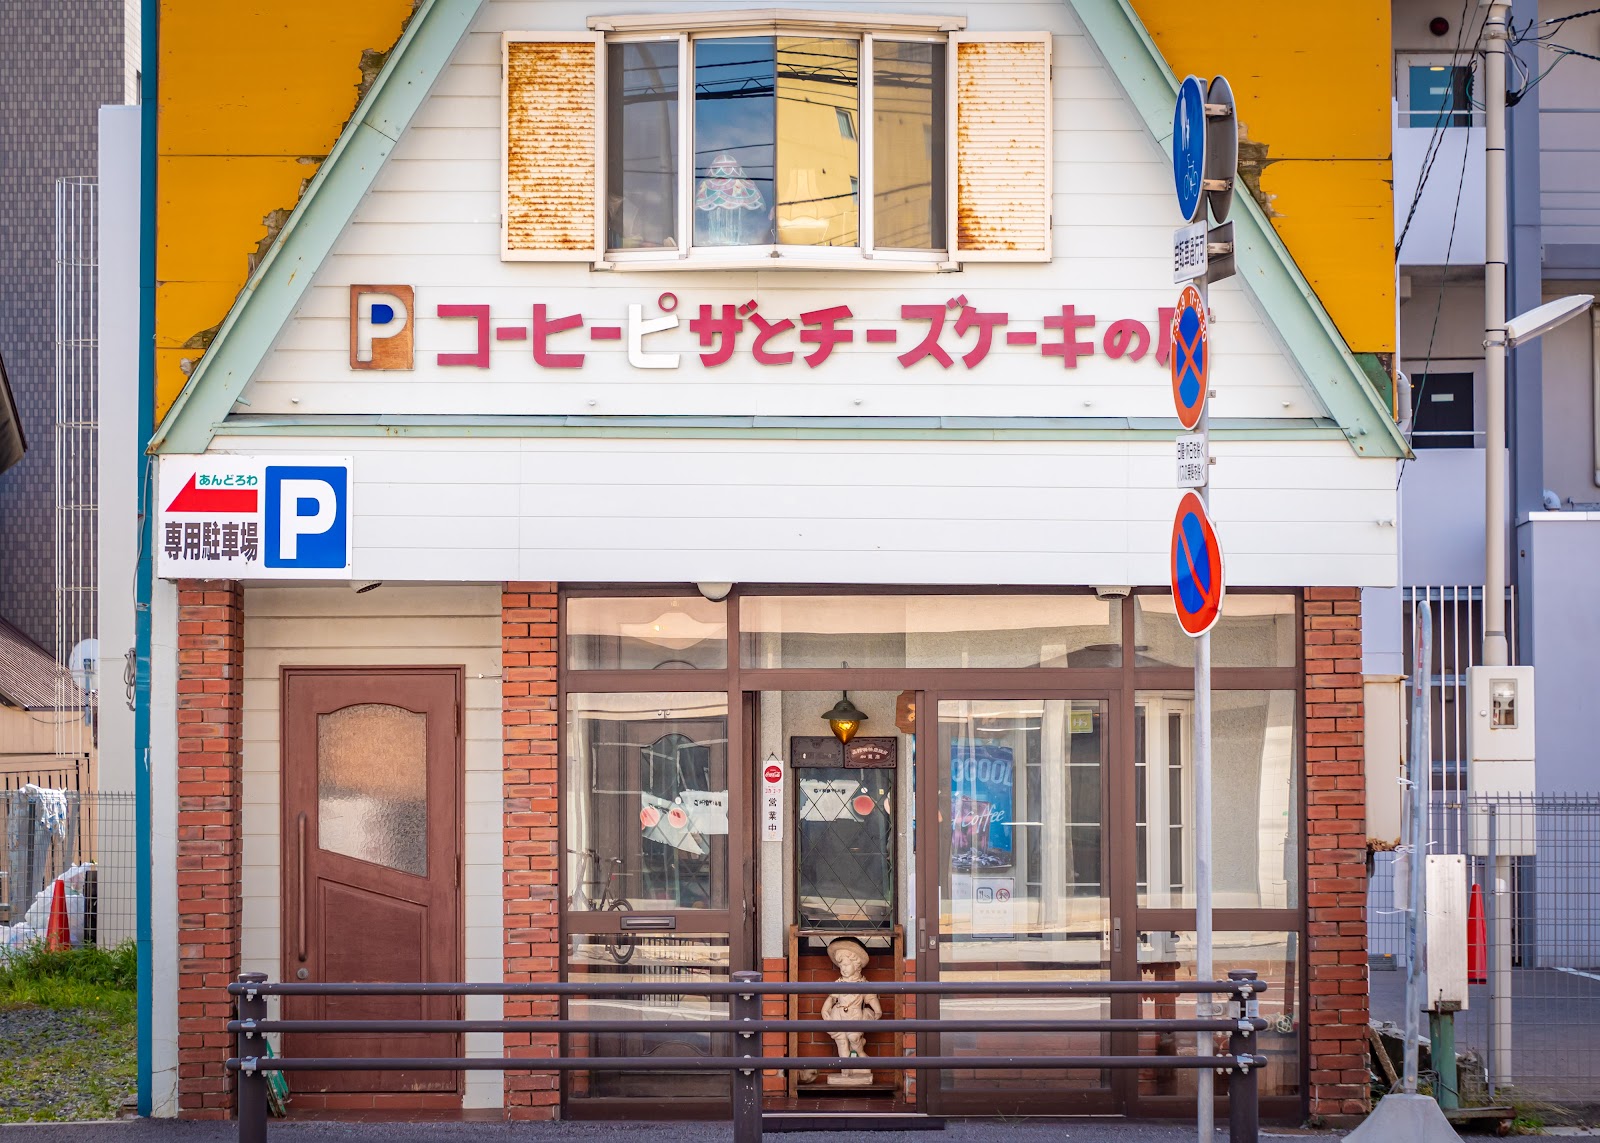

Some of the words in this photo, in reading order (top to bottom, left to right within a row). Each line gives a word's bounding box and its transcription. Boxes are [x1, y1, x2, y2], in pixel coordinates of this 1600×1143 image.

[437, 292, 1175, 370] コーヒーピザとチーズケーキの
[199, 474, 258, 486] あんどろわ
[279, 479, 337, 560] P
[164, 521, 259, 561] 専用駐車場
[768, 797, 777, 831] 営業中
